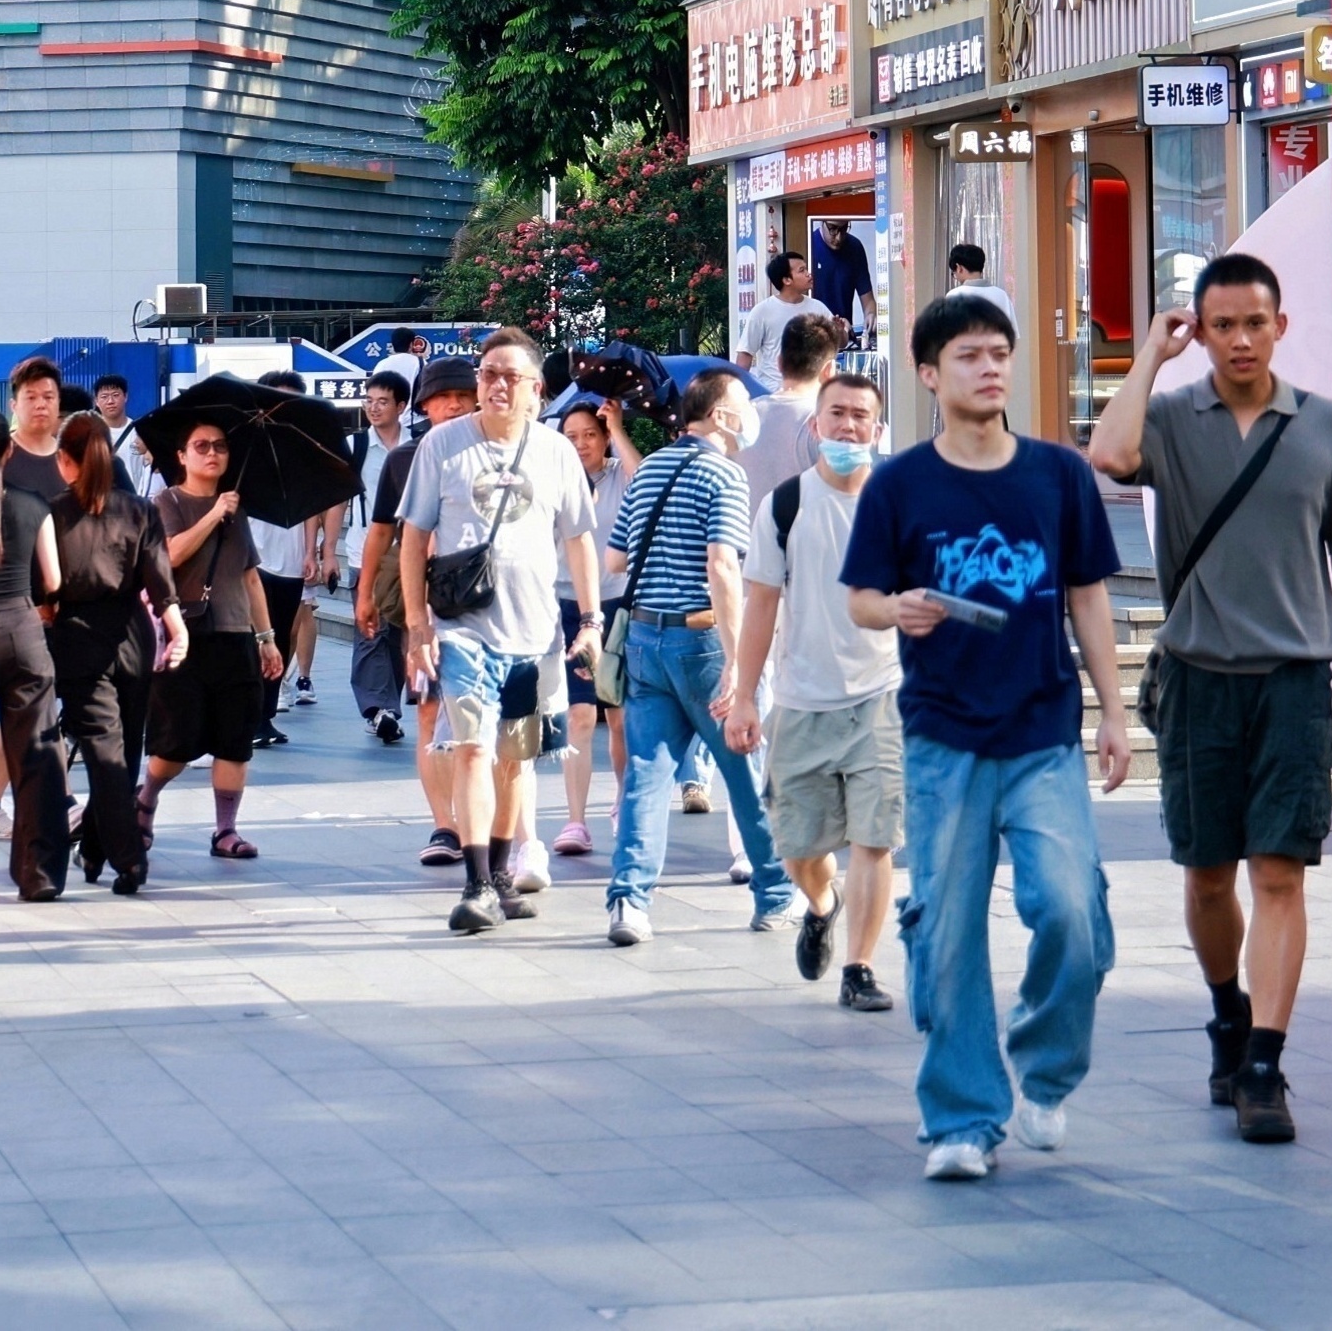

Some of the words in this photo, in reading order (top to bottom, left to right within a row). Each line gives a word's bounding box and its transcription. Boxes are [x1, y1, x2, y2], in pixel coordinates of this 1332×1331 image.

[691, 1, 839, 113] 手机电脑维修总部
[1148, 82, 1224, 107] 手机维修
[959, 130, 1032, 155] 周六福
[434, 341, 483, 357] POLIC
